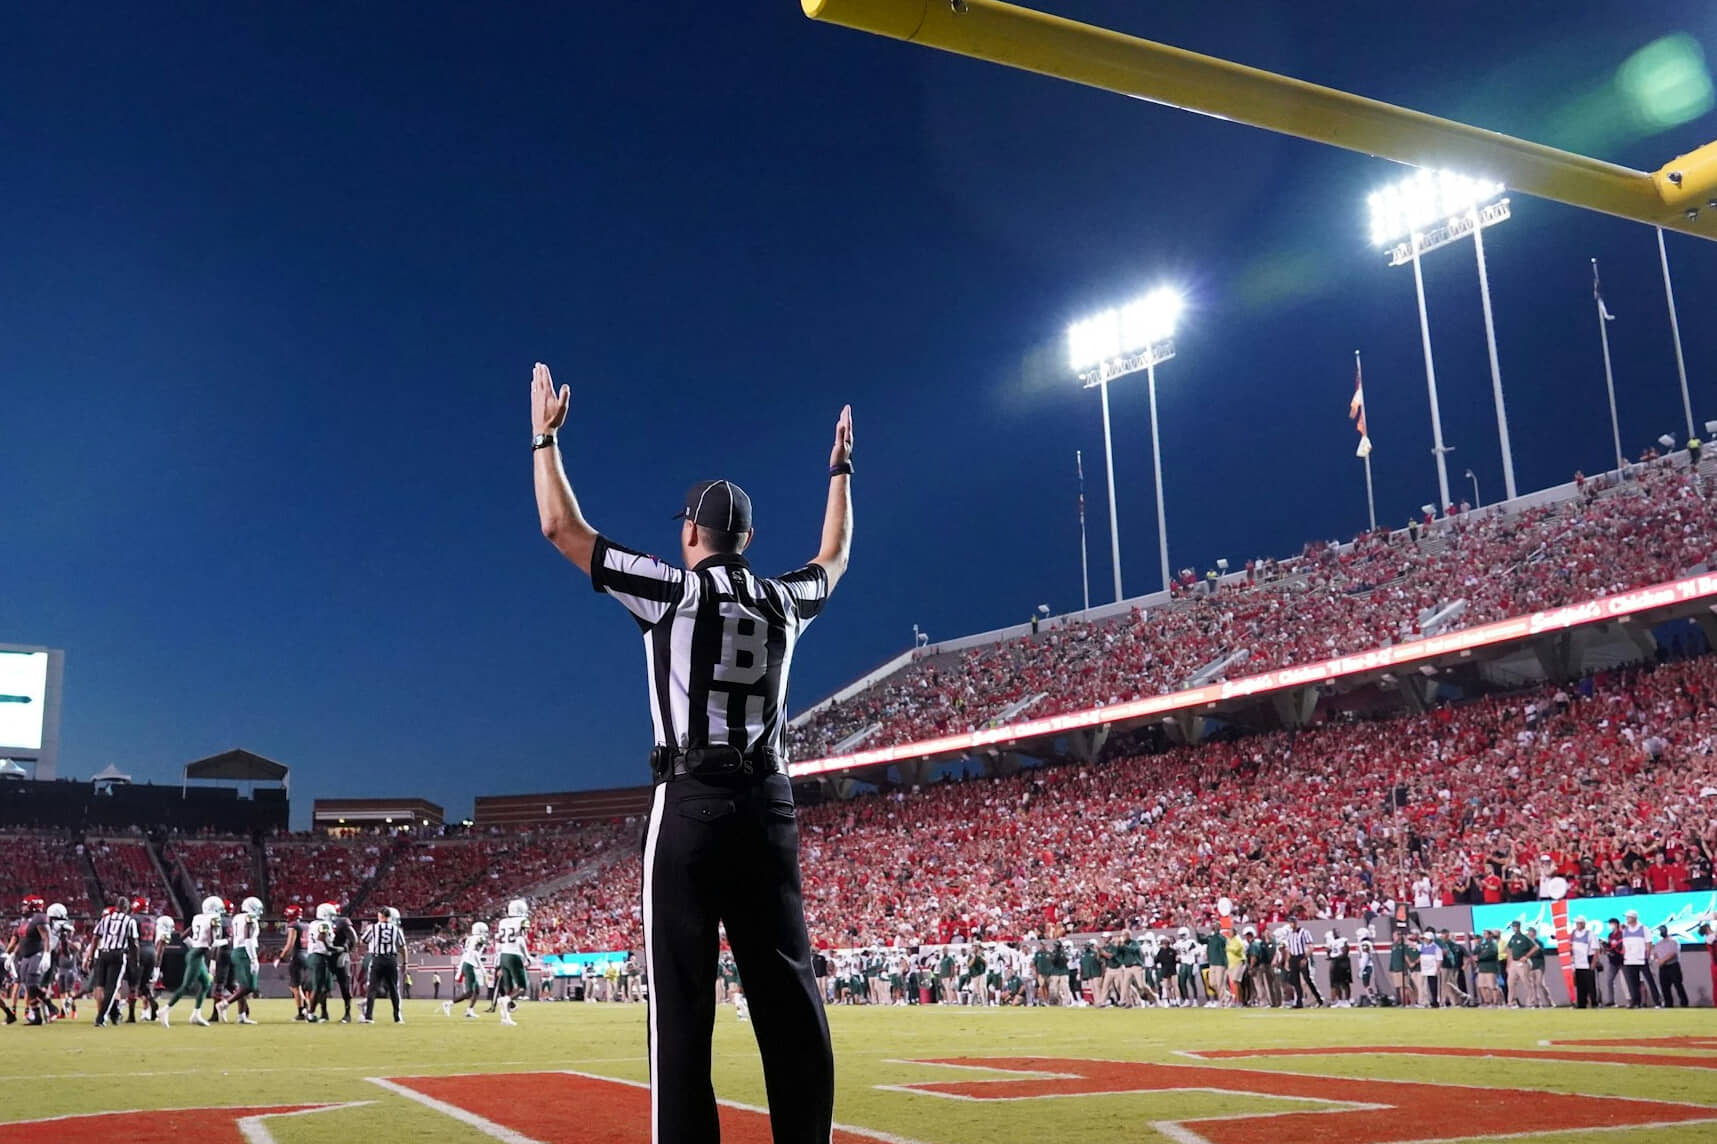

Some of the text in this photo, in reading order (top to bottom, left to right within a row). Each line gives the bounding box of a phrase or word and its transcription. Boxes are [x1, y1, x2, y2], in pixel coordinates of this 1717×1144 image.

[713, 602, 768, 685] B
[381, 930, 392, 944] S
[500, 927, 516, 944] 22
